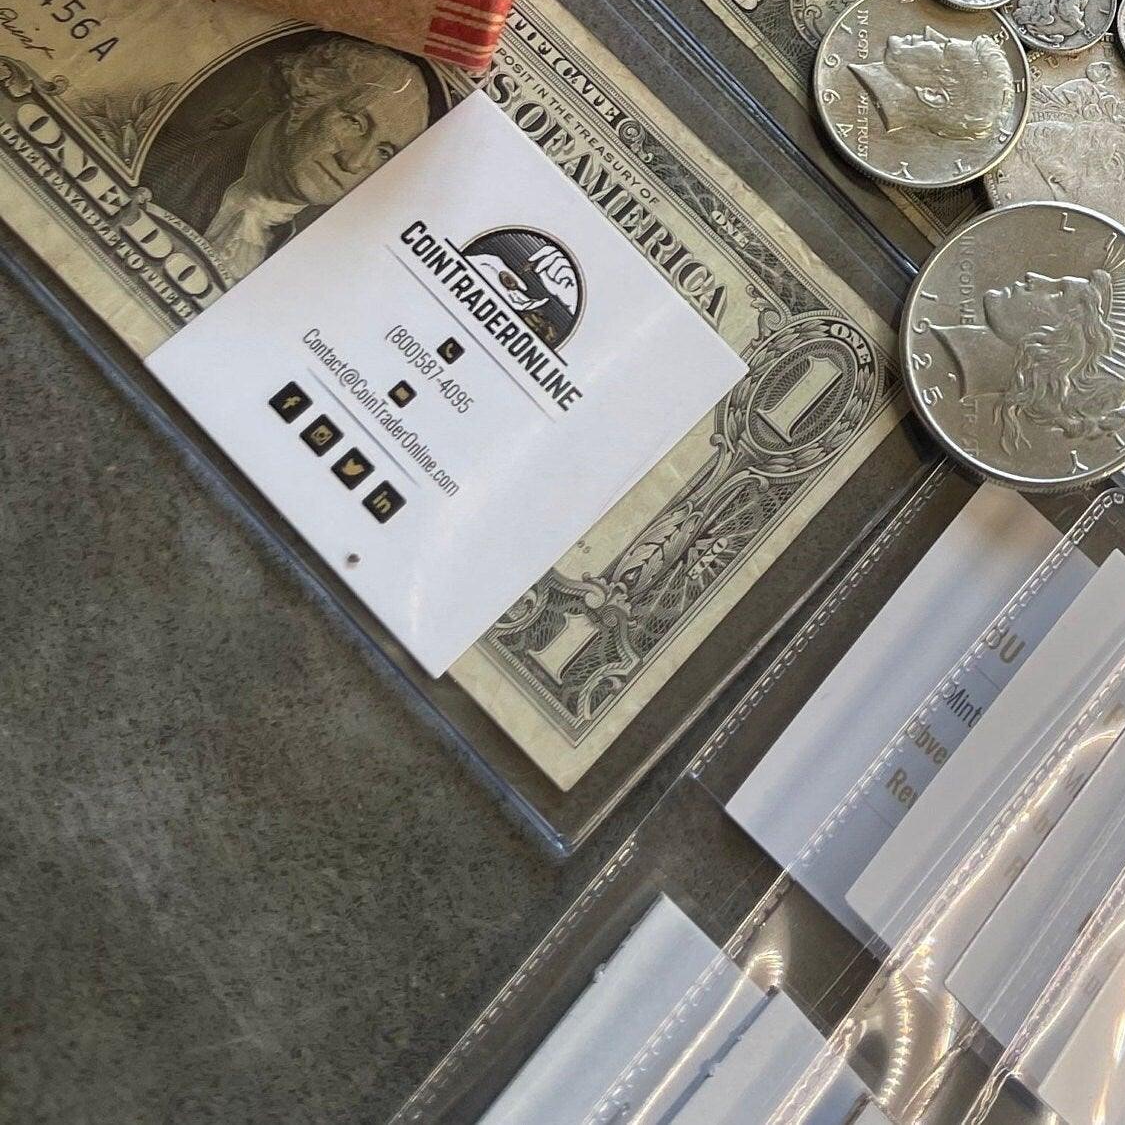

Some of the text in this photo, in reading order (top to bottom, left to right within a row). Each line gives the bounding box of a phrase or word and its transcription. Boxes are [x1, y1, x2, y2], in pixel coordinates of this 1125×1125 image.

[822, 22, 855, 139] 1964
[857, 9, 869, 60] IN GOD
[11, 94, 131, 220] ONE
[494, 45, 534, 85] POSIT
[532, 82, 549, 99] IN
[548, 97, 575, 124] THE
[572, 121, 642, 189] TREASURY
[639, 185, 661, 207] OF
[856, 118, 869, 161] TRUST
[45, 169, 178, 307] PAYABLE TO THE
[515, 97, 729, 326] OF AMERICA
[710, 209, 751, 247] ONE
[399, 219, 584, 413] COINTRADERONLINE
[829, 323, 873, 365] ONE
[302, 326, 461, 499] Contact@CoinTraderOnline.com
[384, 324, 475, 417] (800)587-4095
[755, 356, 843, 443] 1
[528, 612, 601, 685] 1
